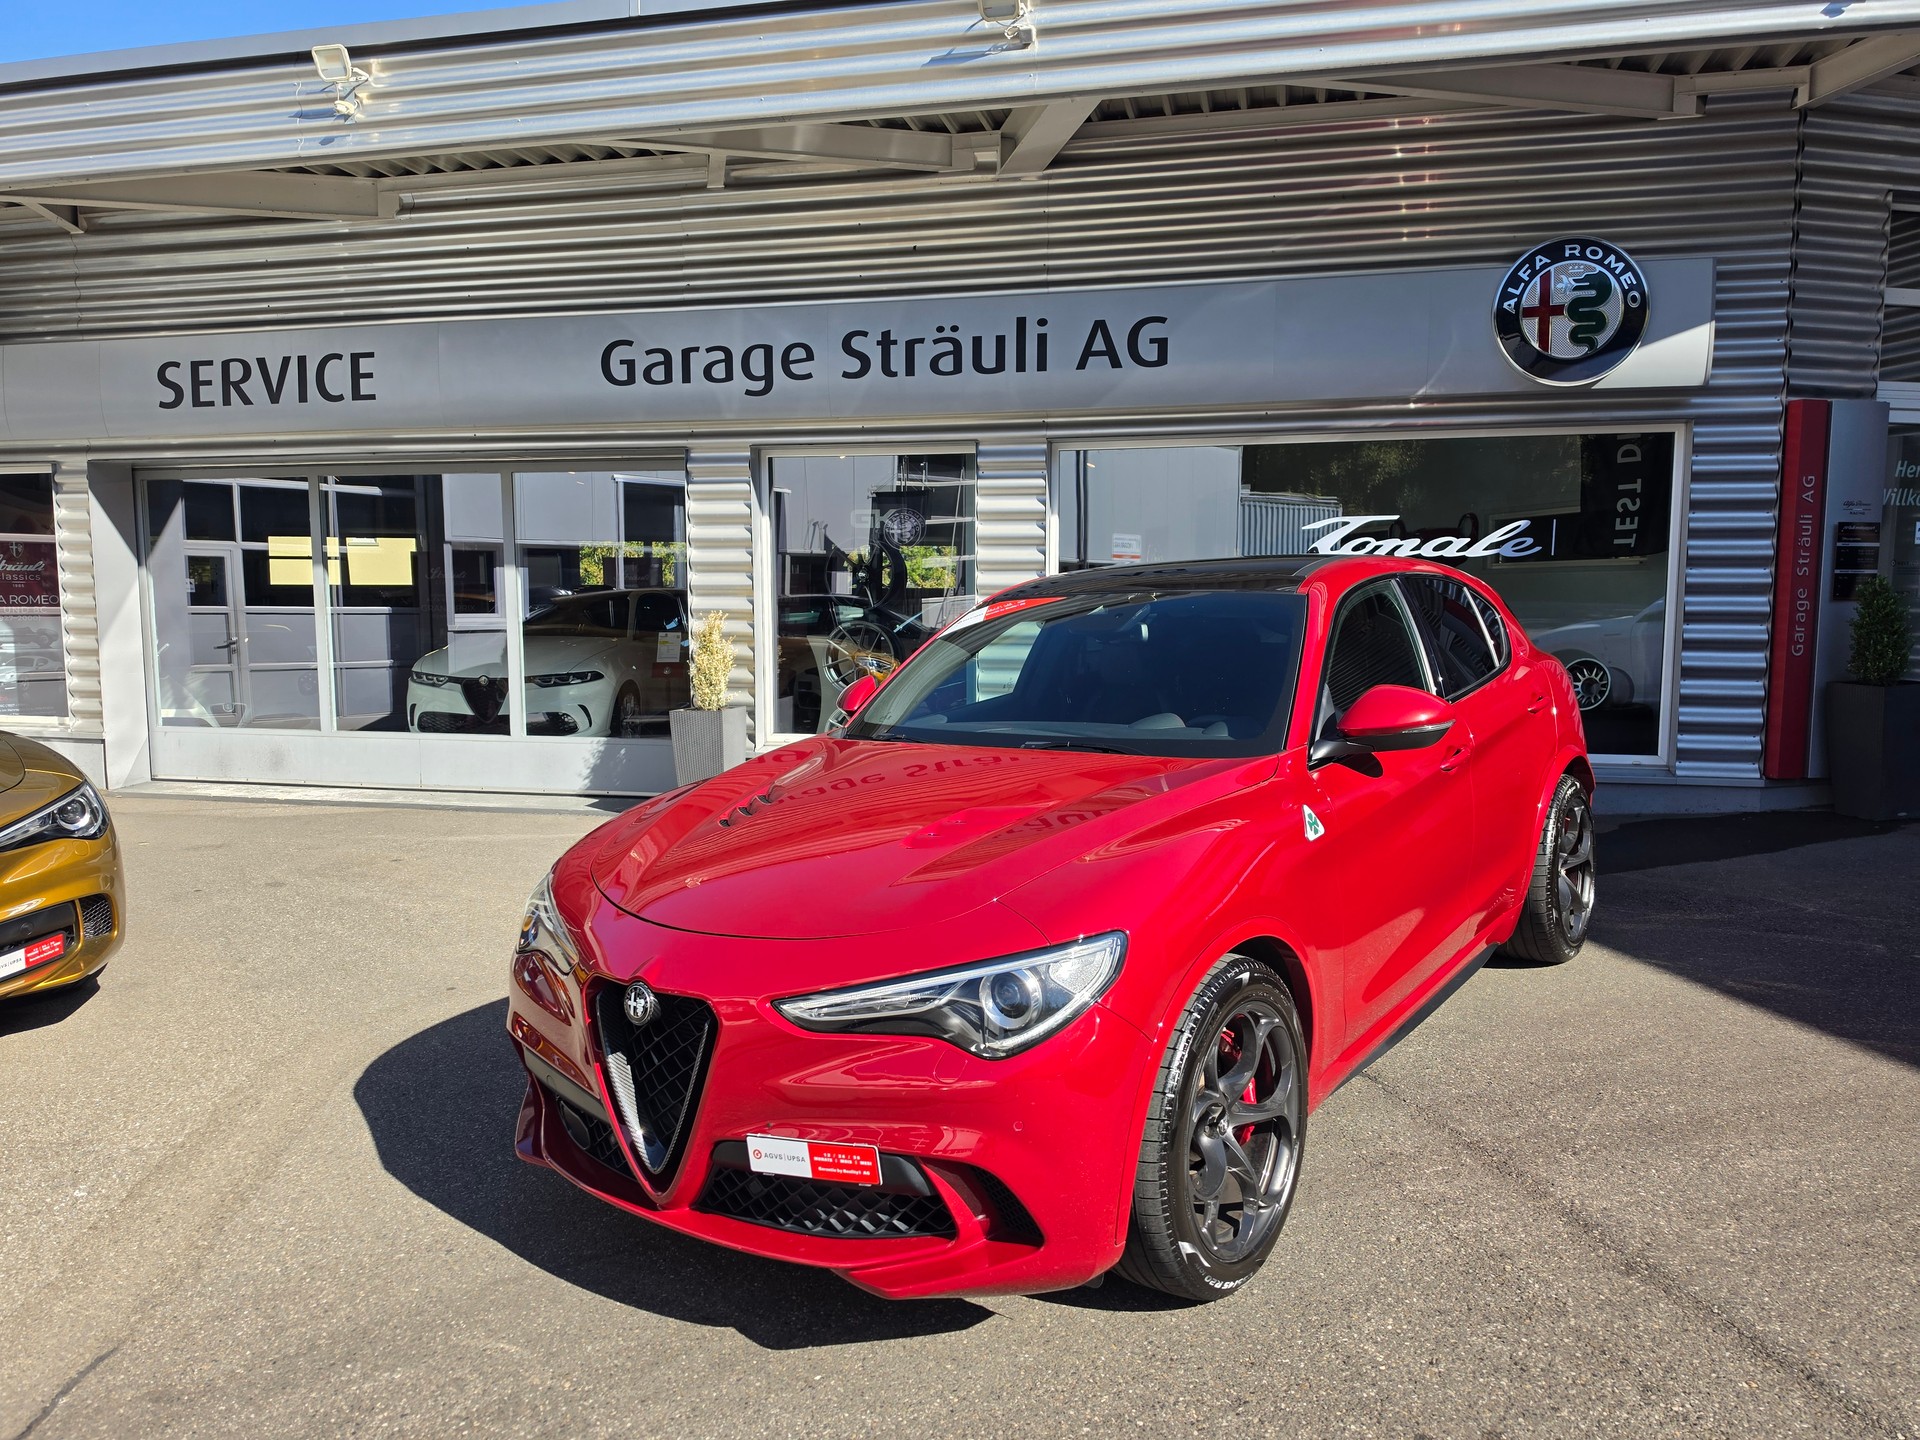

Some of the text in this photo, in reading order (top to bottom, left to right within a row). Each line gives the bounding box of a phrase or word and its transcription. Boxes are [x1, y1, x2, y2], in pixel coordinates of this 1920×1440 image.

[1502, 244, 1641, 314] ALFA ROMEO
[157, 351, 377, 410] SERVICE
[600, 316, 1169, 397] Garage Sträuli AG
[1301, 514, 1543, 557] Tonale
[0, 573, 41, 581] lassics
[1791, 475, 1816, 656] Garage Sträuli AG
[9, 594, 59, 605] ROMEO
[764, 1152, 806, 1163] AGVS UPSA
